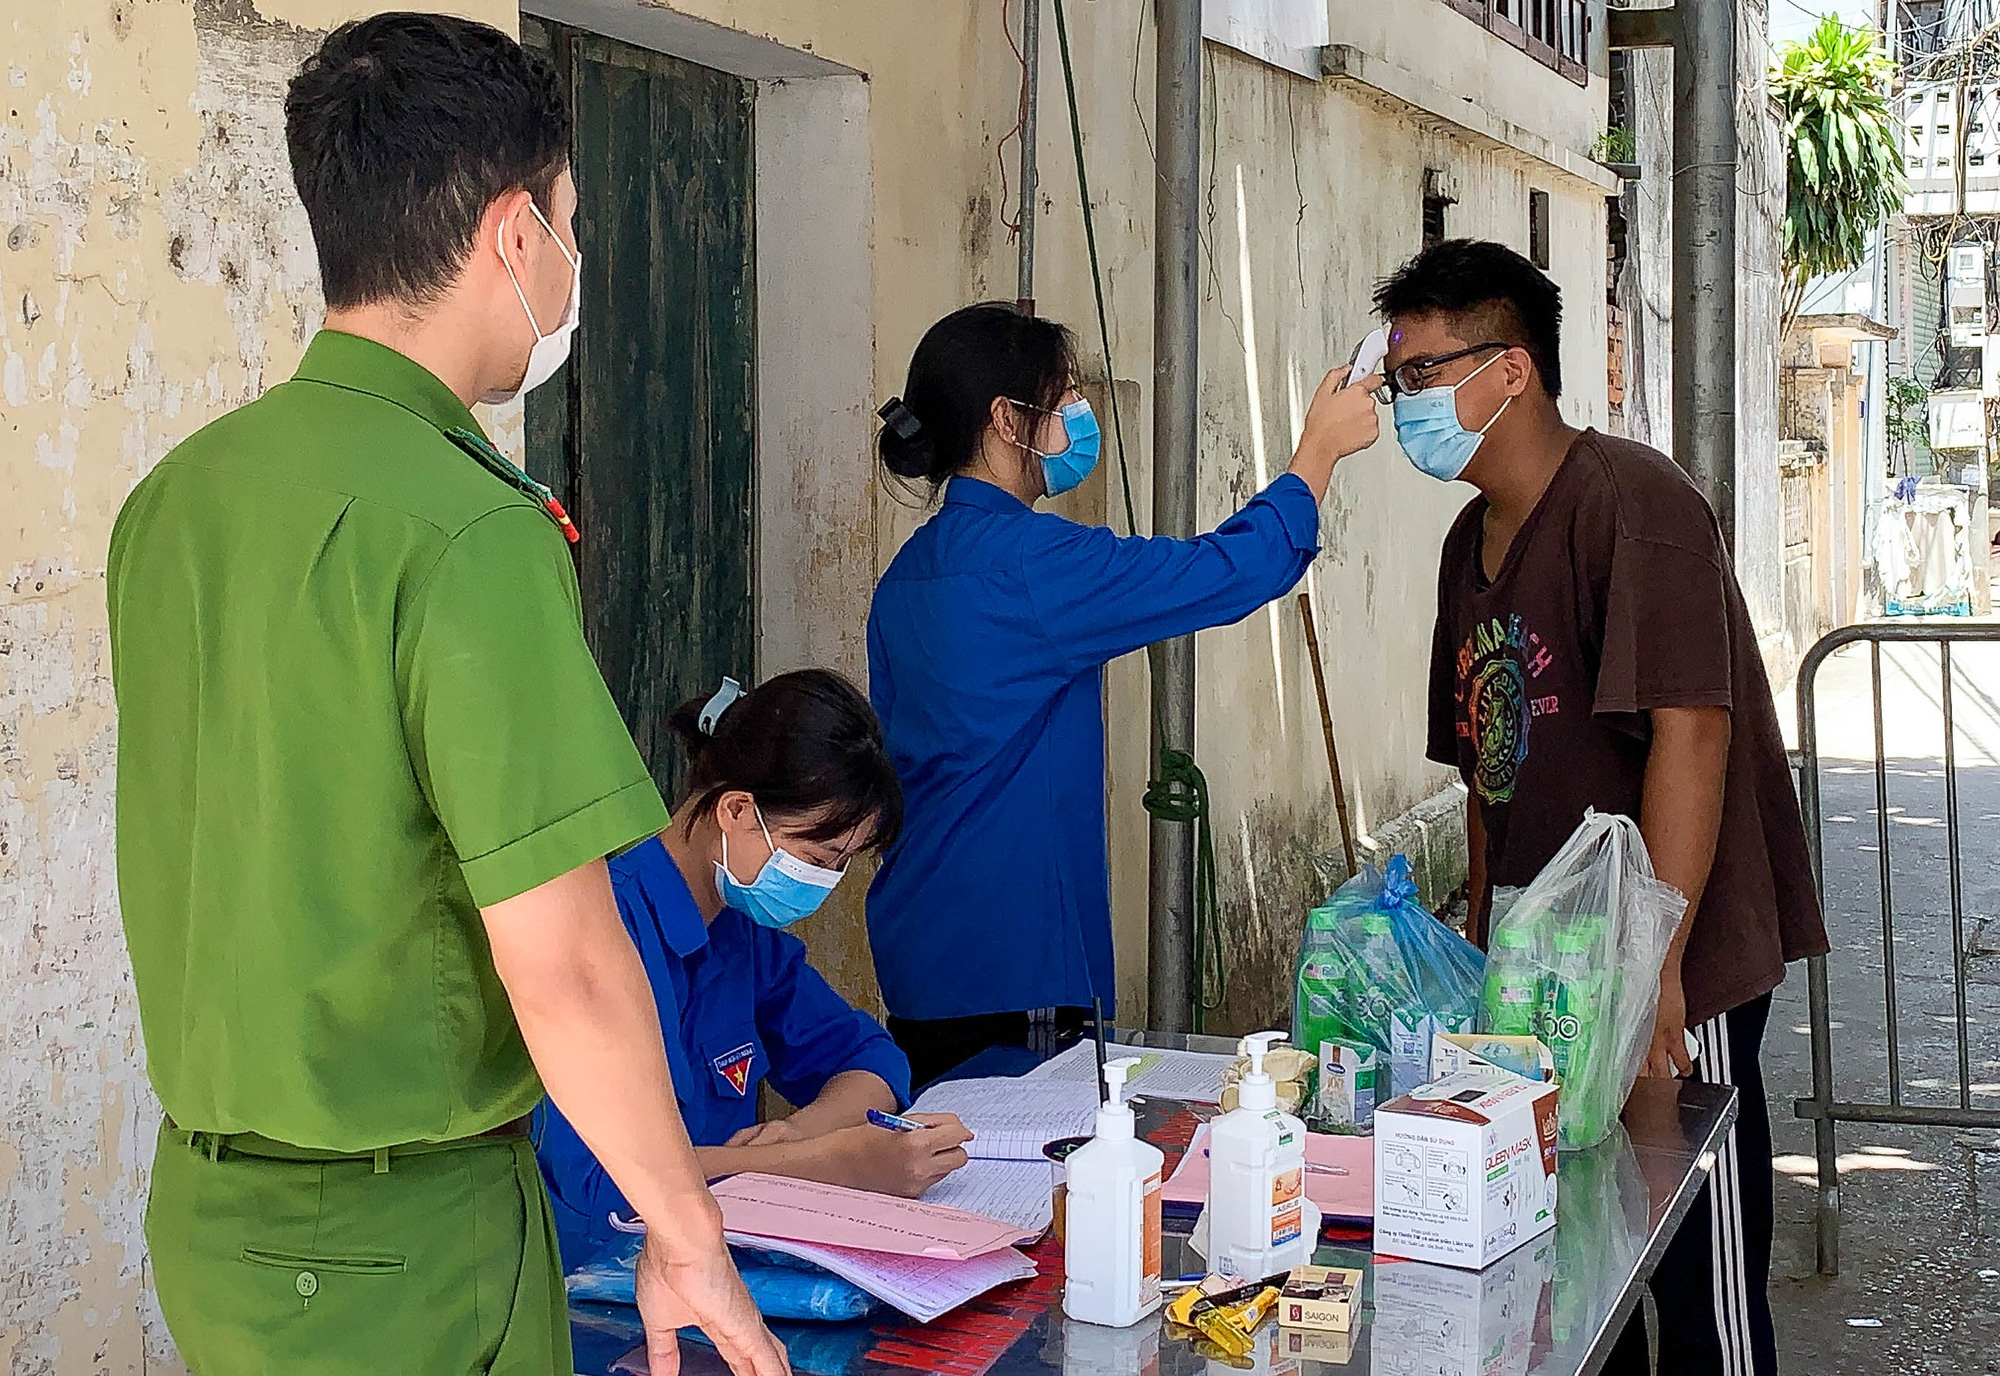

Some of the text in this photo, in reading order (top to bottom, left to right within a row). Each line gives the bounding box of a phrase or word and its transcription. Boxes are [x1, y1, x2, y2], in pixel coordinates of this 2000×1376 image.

[1531, 695, 1559, 717] EVER
[1485, 1146, 1511, 1171] QUEEN
[1511, 1136, 1532, 1157] MASK
[1304, 1311, 1340, 1322] SAIGON
